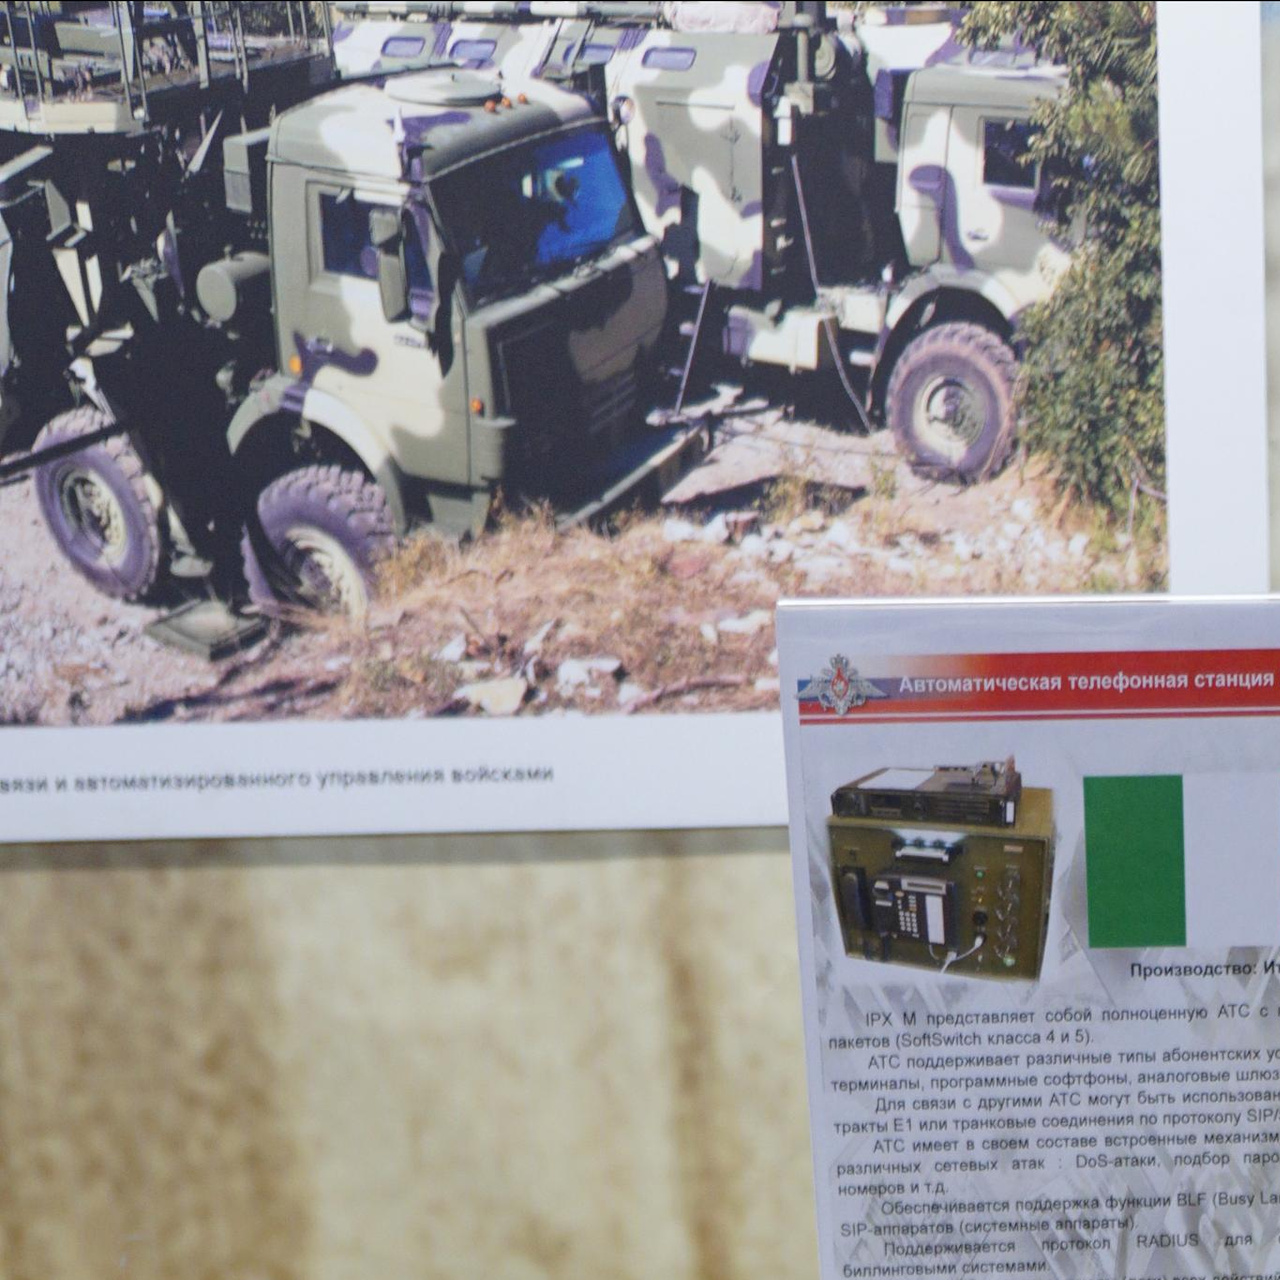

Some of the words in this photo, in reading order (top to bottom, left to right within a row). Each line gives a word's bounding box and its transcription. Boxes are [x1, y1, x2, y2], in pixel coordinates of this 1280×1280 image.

[899, 675, 1062, 693] Автоматическая
[1068, 671, 1188, 693] телефонная
[1194, 671, 1275, 689] станция
[55, 775, 68, 792] и
[74, 771, 311, 793] автоматизированного
[317, 769, 445, 790] управления
[452, 765, 555, 784] войсками
[1130, 962, 1258, 979] Производство:
[865, 1013, 892, 1025] IPX
[926, 1012, 1035, 1027] представляет
[1044, 1009, 1092, 1022] собой
[1101, 1008, 1208, 1023] полноценную
[829, 1036, 891, 1047] пакетов
[896, 1032, 982, 1049] (SoftSwitch
[988, 1033, 1042, 1044] класса
[1046, 1031, 1056, 1043] 4
[1061, 1032, 1070, 1042] и
[1075, 1030, 1094, 1045] 5).
[906, 1054, 1020, 1070] поддерживает
[1026, 1052, 1112, 1067] различные
[1117, 1051, 1156, 1062] типы
[1162, 1047, 1260, 1061] абонентских
[830, 1078, 924, 1093] терминалы,
[930, 1075, 1038, 1091] программные
[1043, 1071, 1132, 1088] софтфоны,
[1137, 1071, 1231, 1083] аналоговые
[874, 1098, 906, 1110] Для
[912, 1098, 956, 1109] связи
[977, 1096, 1042, 1111] другими
[1088, 1094, 1131, 1108] могут
[1137, 1092, 1176, 1104] быть
[833, 1121, 888, 1135] тракты
[918, 1119, 947, 1130] или
[952, 1117, 1036, 1132] транковые
[1041, 1115, 1134, 1129] соединения
[1139, 1114, 1158, 1125] по
[1162, 1112, 1241, 1127] протоколу
[912, 1139, 959, 1150] имеет
[981, 1138, 1029, 1149] своем
[1036, 1136, 1097, 1148] составе
[1104, 1134, 1197, 1149] встроенные
[836, 1162, 921, 1177] различных
[933, 1160, 998, 1171] сетевых
[1011, 1159, 1044, 1170] атак
[1075, 1156, 1161, 1169] DoS-атаки,
[1174, 1152, 1230, 1168] подбор
[837, 1183, 905, 1197] номеров
[909, 1182, 919, 1193] и
[923, 1182, 948, 1194] т.д.
[880, 1198, 1010, 1213] Обеспечивается
[1015, 1198, 1101, 1213] поддержка
[1105, 1194, 1172, 1211] функции
[1176, 1192, 1206, 1206] BLF
[1212, 1192, 1255, 1208] (Busy
[840, 1221, 954, 1238] SIP-аппаратов
[959, 1218, 1050, 1235] (системные
[1055, 1216, 1138, 1233] аппараты).
[884, 1238, 1016, 1256] Поддерживается
[1042, 1237, 1112, 1252] протокол
[1137, 1234, 1200, 1247] RADIUS
[1224, 1235, 1254, 1247] для
[842, 1261, 957, 1275] биллинговыми
[961, 1261, 1051, 1273] системами.
